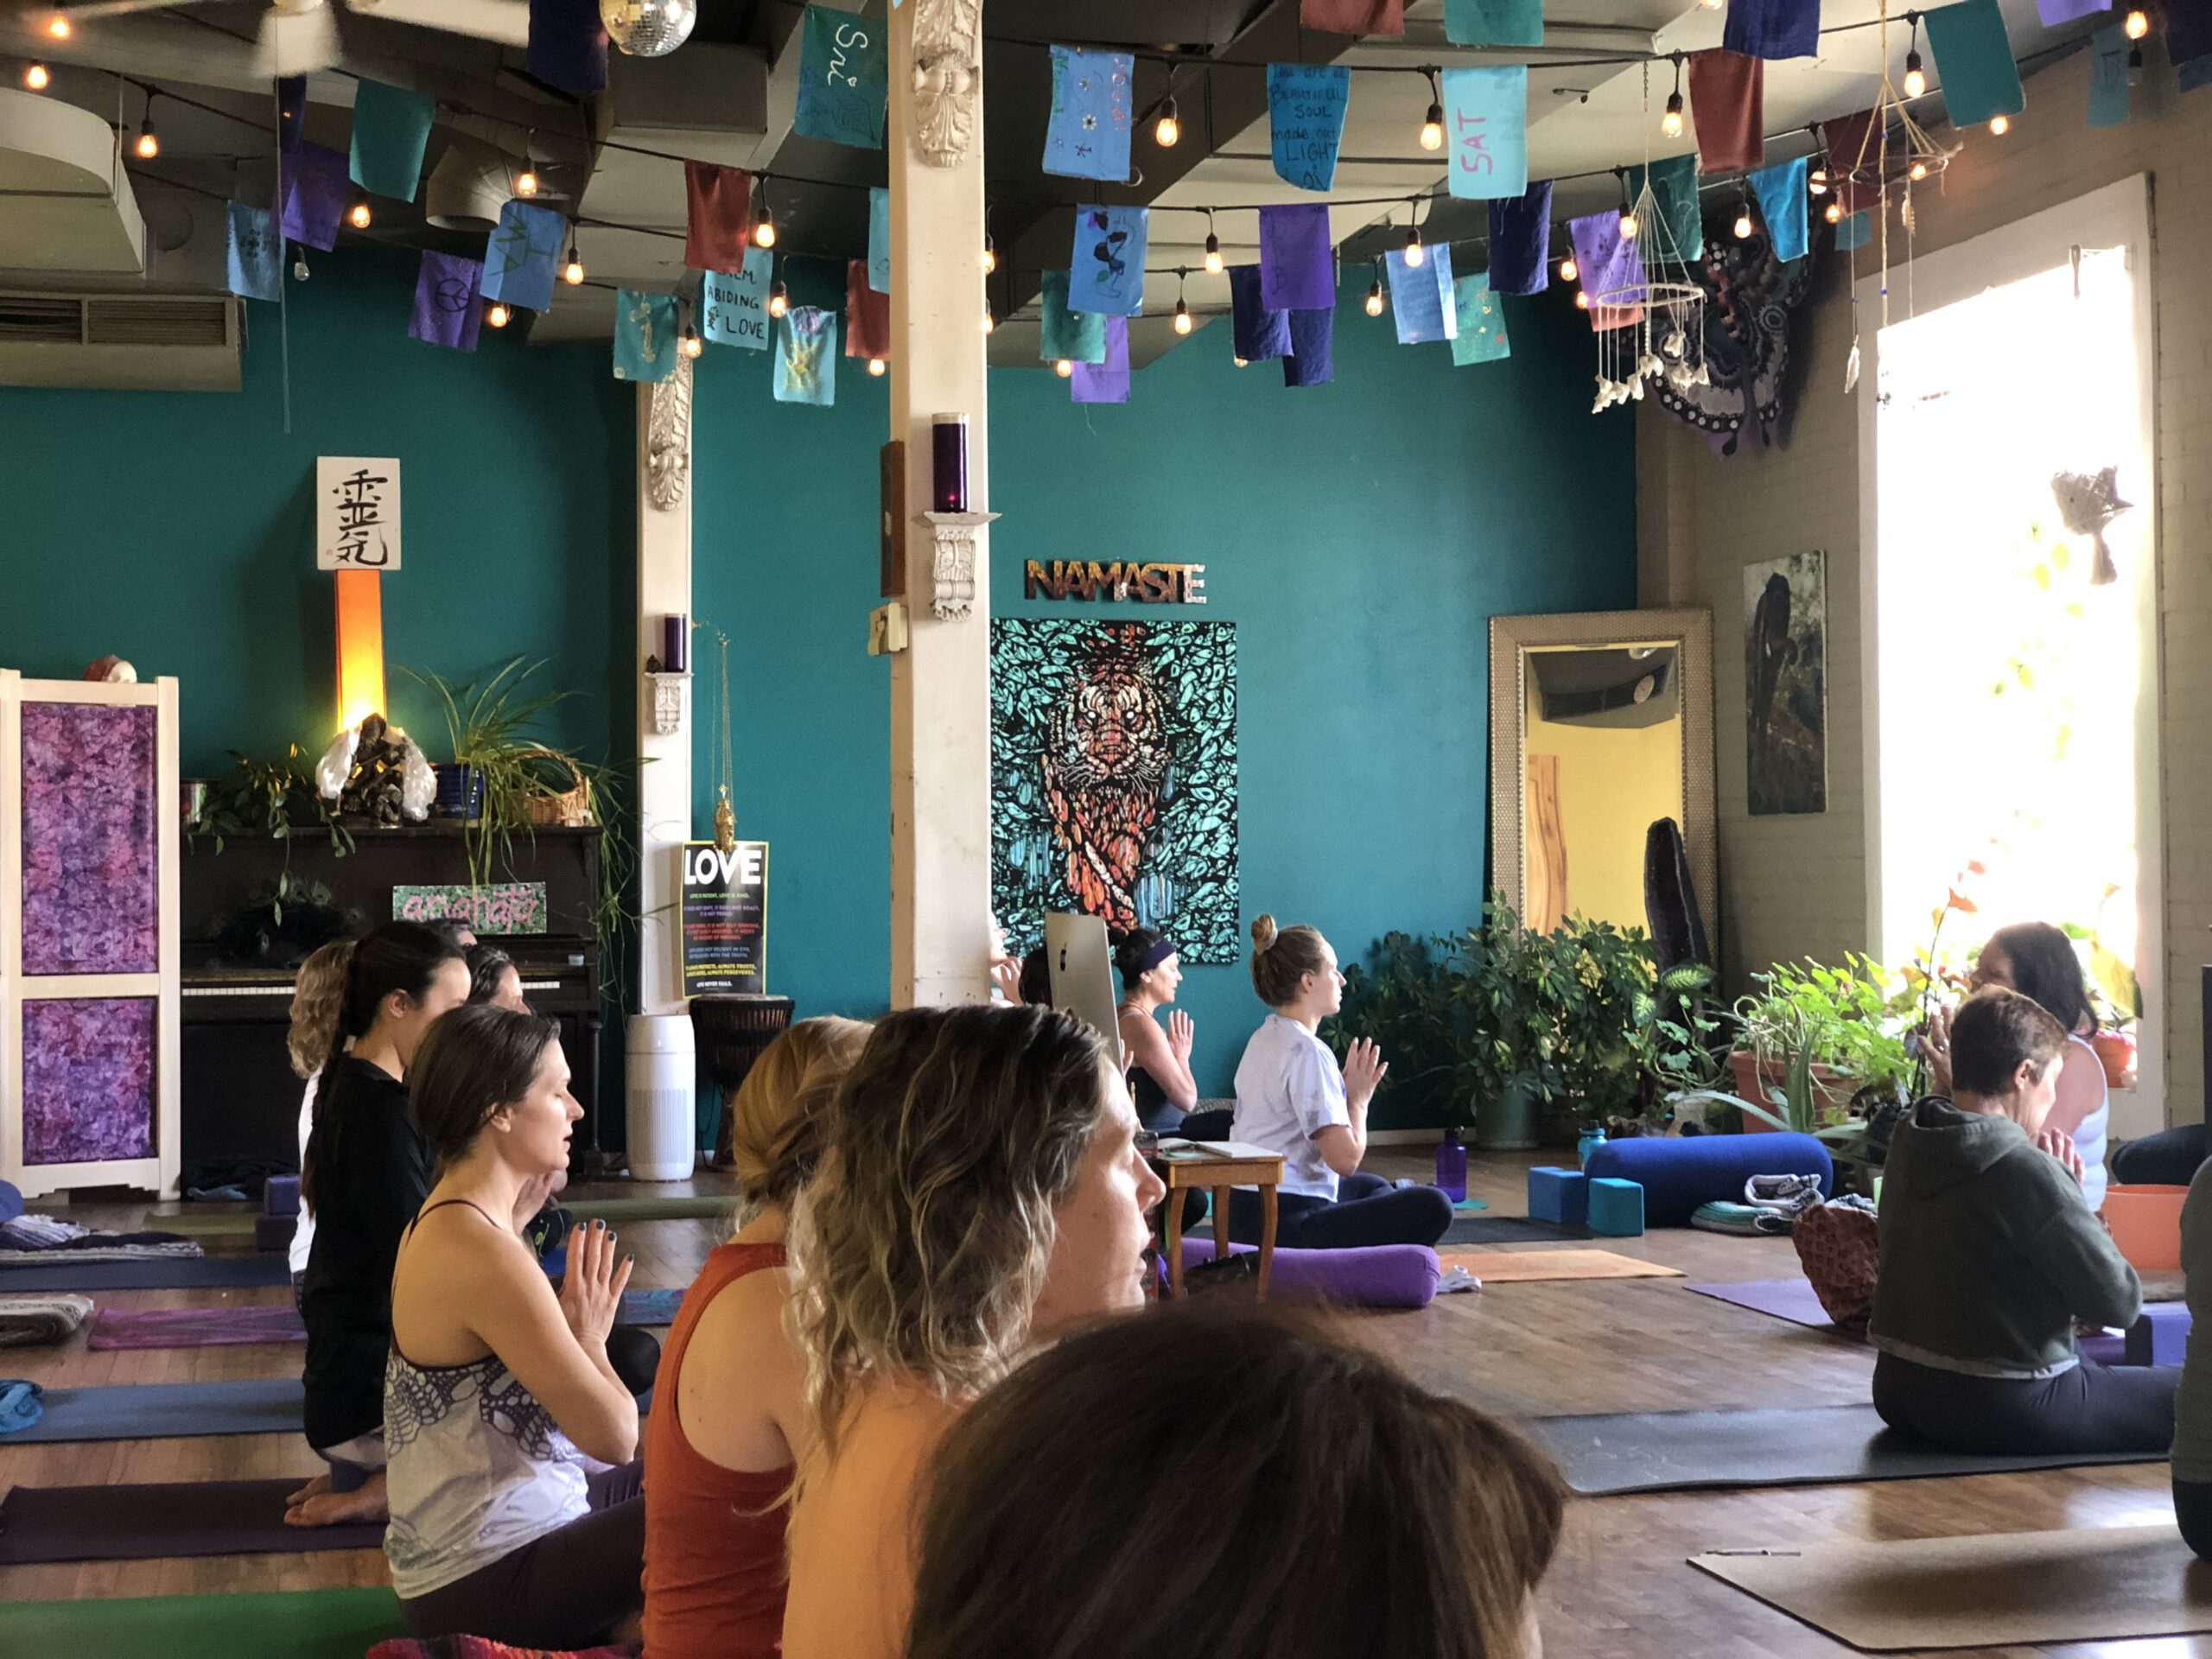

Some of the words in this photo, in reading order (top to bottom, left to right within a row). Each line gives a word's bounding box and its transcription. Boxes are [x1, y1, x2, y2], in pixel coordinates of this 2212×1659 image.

[828, 23, 868, 86] Sri
[1295, 104, 1332, 119] SOUL
[1285, 141, 1339, 162] LIGHT
[1457, 106, 1494, 175] SAT
[707, 284, 760, 309] ABIDING
[726, 315, 765, 340] LOVE
[1026, 559, 1207, 603] NAMASTE
[684, 849, 762, 885] LOVE
